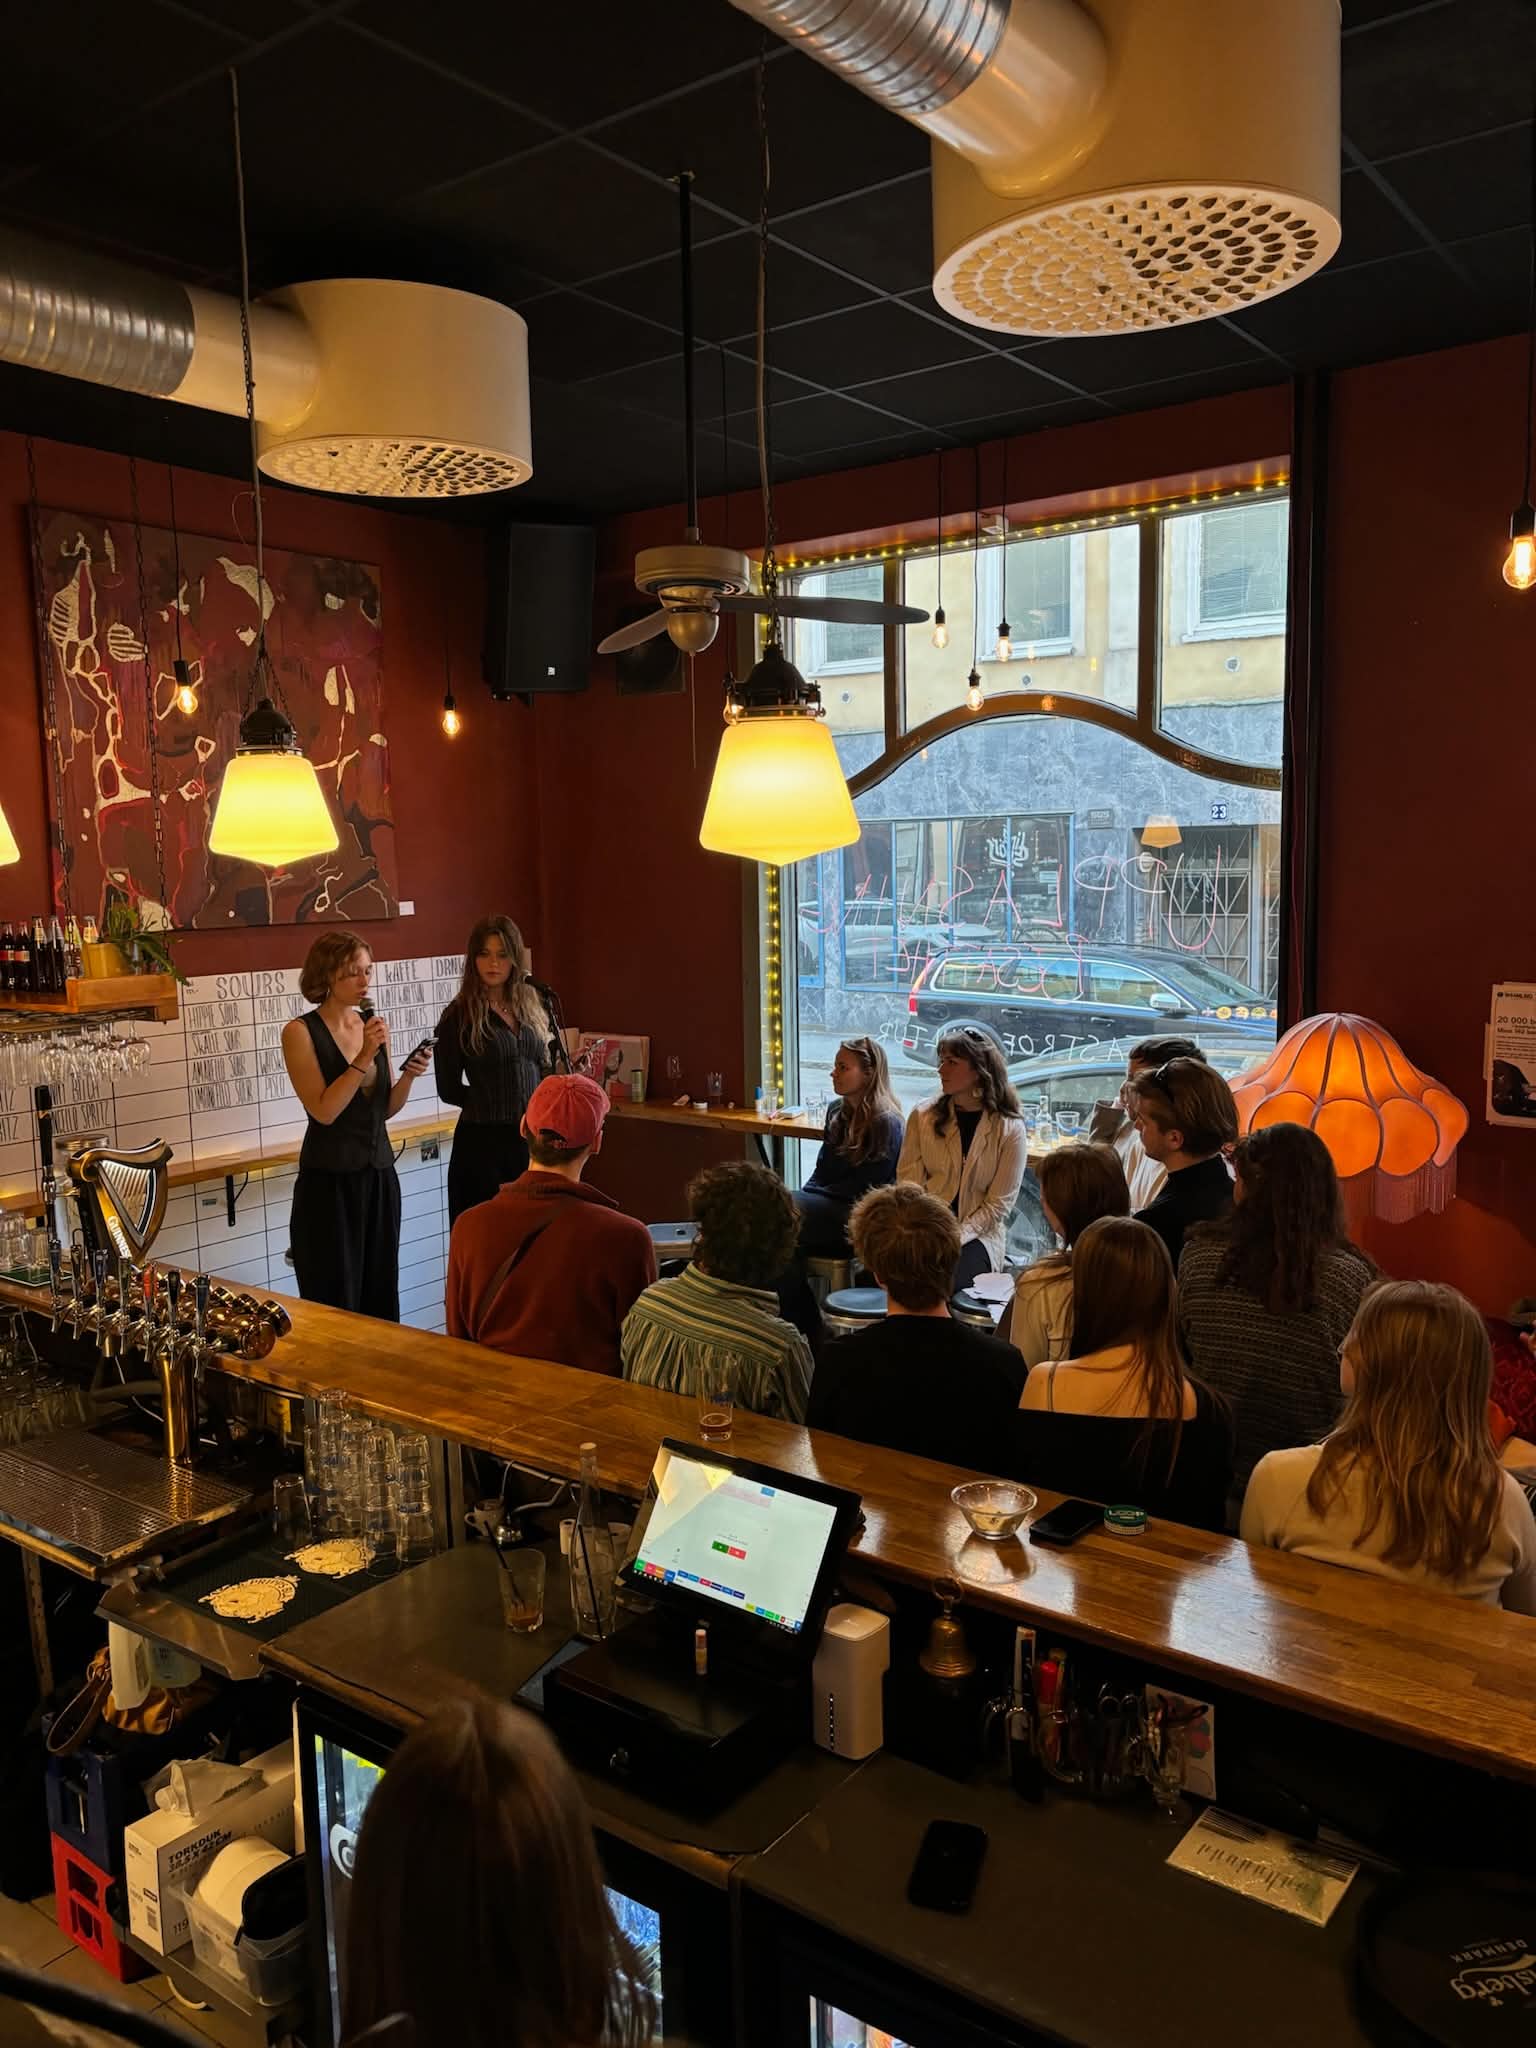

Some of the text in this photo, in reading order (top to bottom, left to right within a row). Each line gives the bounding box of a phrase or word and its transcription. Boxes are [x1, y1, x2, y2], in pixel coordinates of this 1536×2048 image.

[1212, 805, 1227, 819] 23
[385, 960, 418, 983] KAFFE
[216, 971, 285, 1000] SOURS
[1496, 1015, 1509, 1025] 20
[1510, 1016, 1528, 1026] 000
[80, 1101, 112, 1129] SPRITZ
[167, 1828, 222, 1865] TORKDUK
[1448, 1939, 1528, 1963] DENMARK
